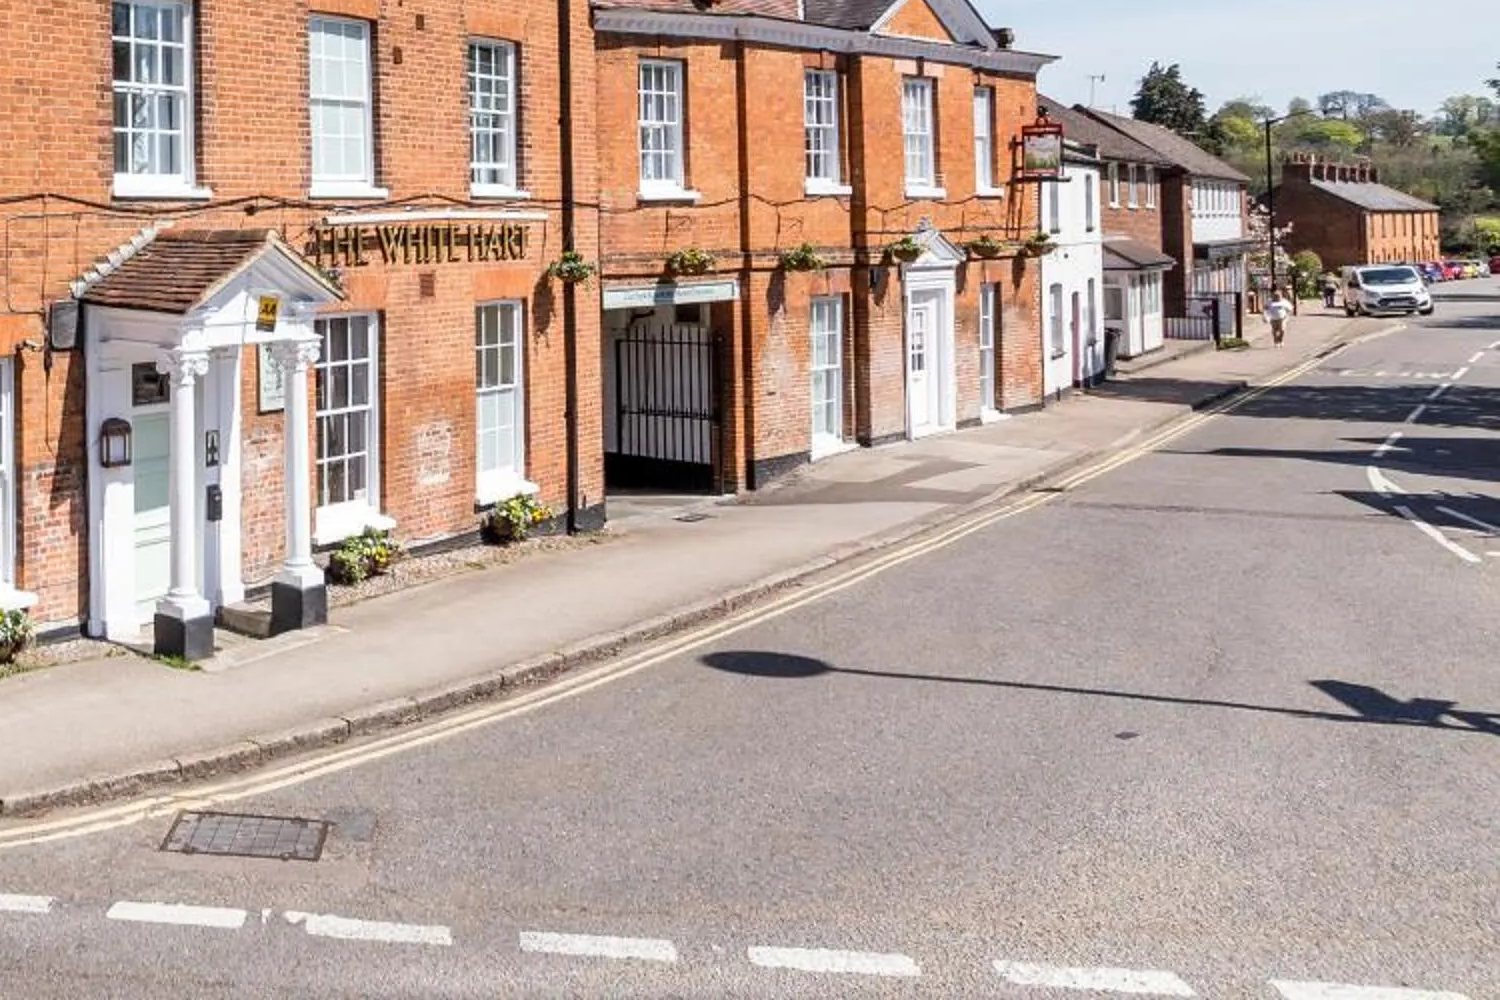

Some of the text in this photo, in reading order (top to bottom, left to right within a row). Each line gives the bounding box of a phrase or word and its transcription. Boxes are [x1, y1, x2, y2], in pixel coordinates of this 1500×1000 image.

[315, 223, 531, 267] THE WHITE HART
